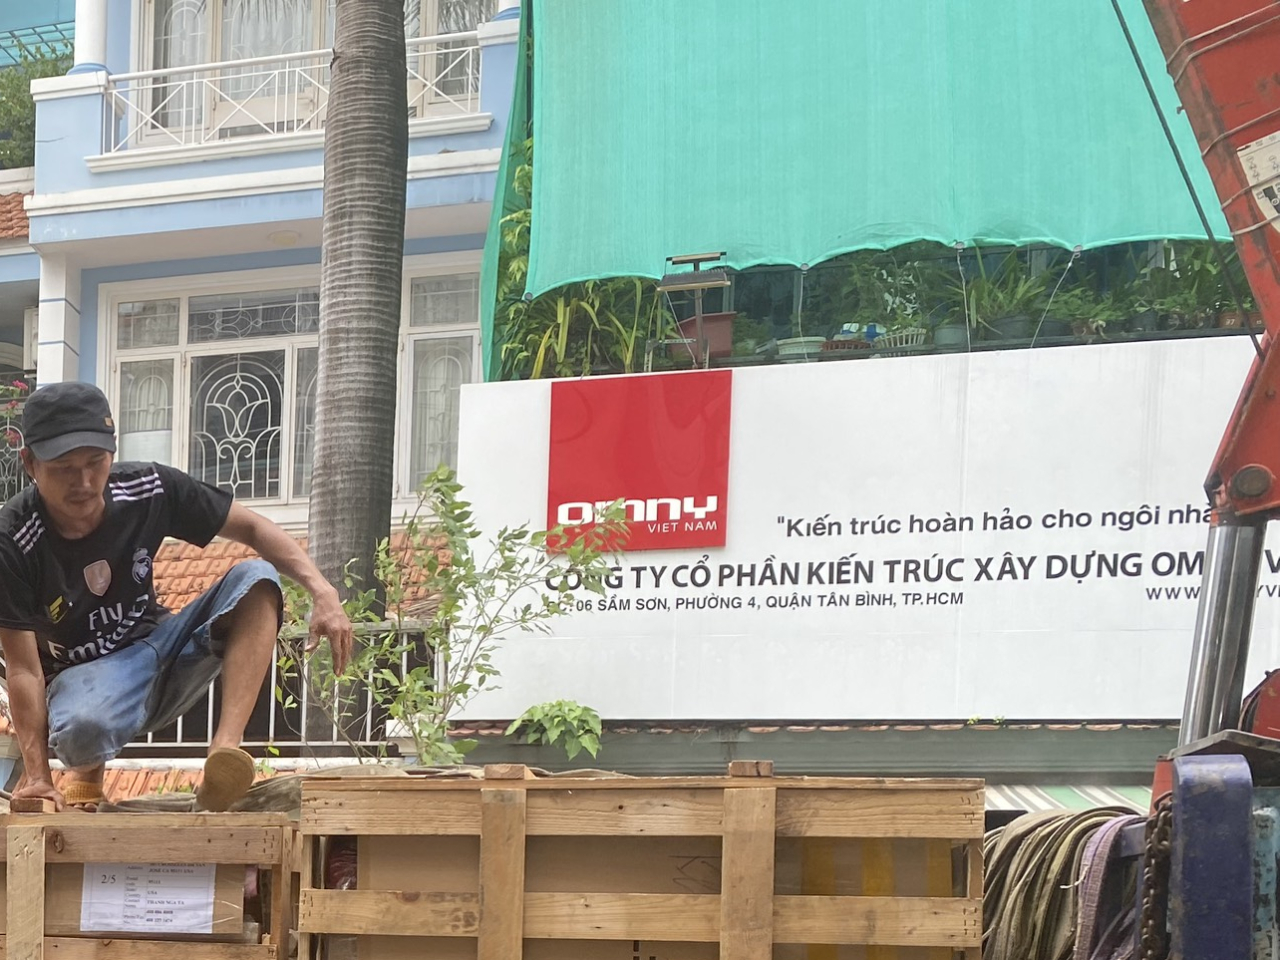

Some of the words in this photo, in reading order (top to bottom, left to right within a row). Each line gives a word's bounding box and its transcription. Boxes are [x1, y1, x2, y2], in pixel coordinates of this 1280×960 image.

[648, 522, 678, 533] VIET
[684, 520, 718, 531] NAM
[850, 514, 901, 535] trúc
[908, 511, 974, 533] hoàn
[982, 507, 1032, 531] hảo
[1041, 509, 1092, 528] cho
[1101, 504, 1161, 531] ngôi
[631, 565, 668, 588] TY
[671, 554, 711, 588] CỔ
[718, 553, 800, 587] PHẦN
[807, 552, 874, 585] KIẾN
[883, 553, 965, 583] TRÚC
[974, 551, 1037, 582] XÂY
[1045, 550, 1143, 584] DỰNG
[576, 599, 593, 612] 06
[597, 594, 631, 611] SẦM
[635, 597, 671, 612] SƠN,
[676, 593, 742, 610] PHƯỜNG
[747, 597, 761, 611] 4,
[766, 592, 812, 610] QUẬN
[817, 591, 850, 607] TÂN
[855, 590, 897, 608] BÌNH,
[88, 602, 124, 631] Fly
[101, 874, 117, 884] 2/5
